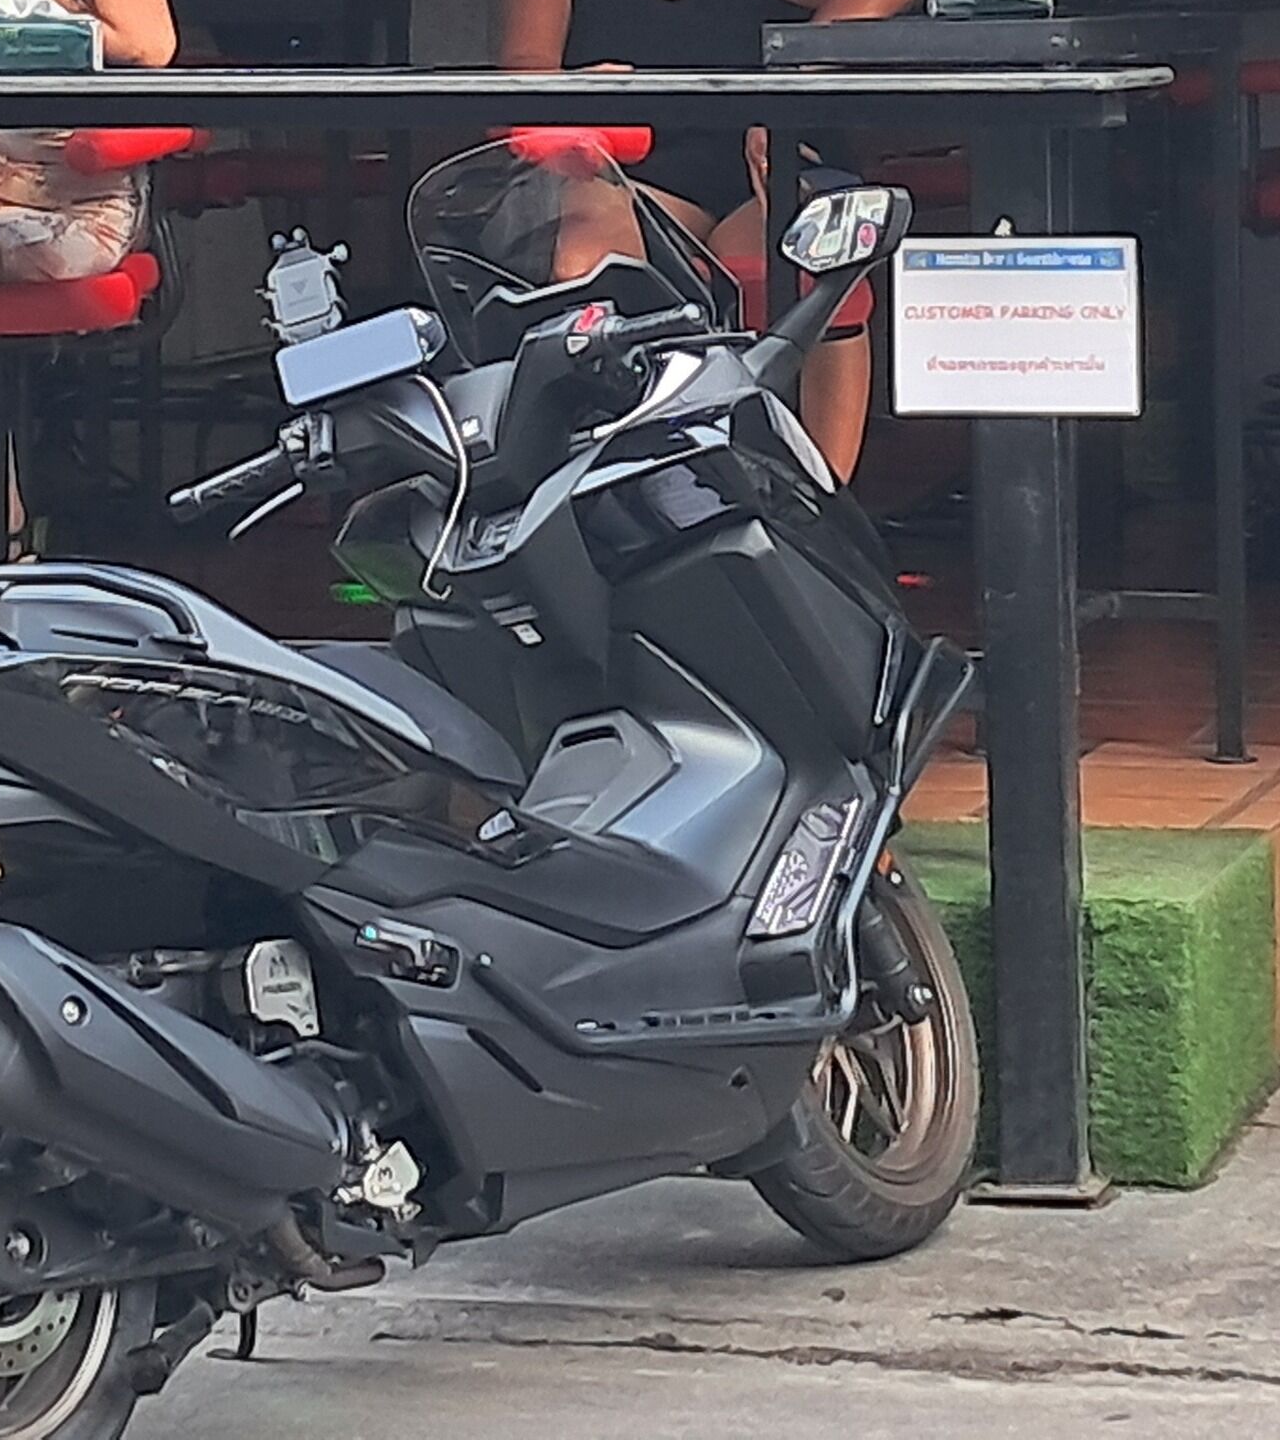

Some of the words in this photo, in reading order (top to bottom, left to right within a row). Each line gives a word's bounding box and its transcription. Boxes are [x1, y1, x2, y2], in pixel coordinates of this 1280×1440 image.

[903, 305, 995, 321] CUSTOMER
[1000, 305, 1074, 320] PARKING
[1079, 304, 1127, 320] ONLY
